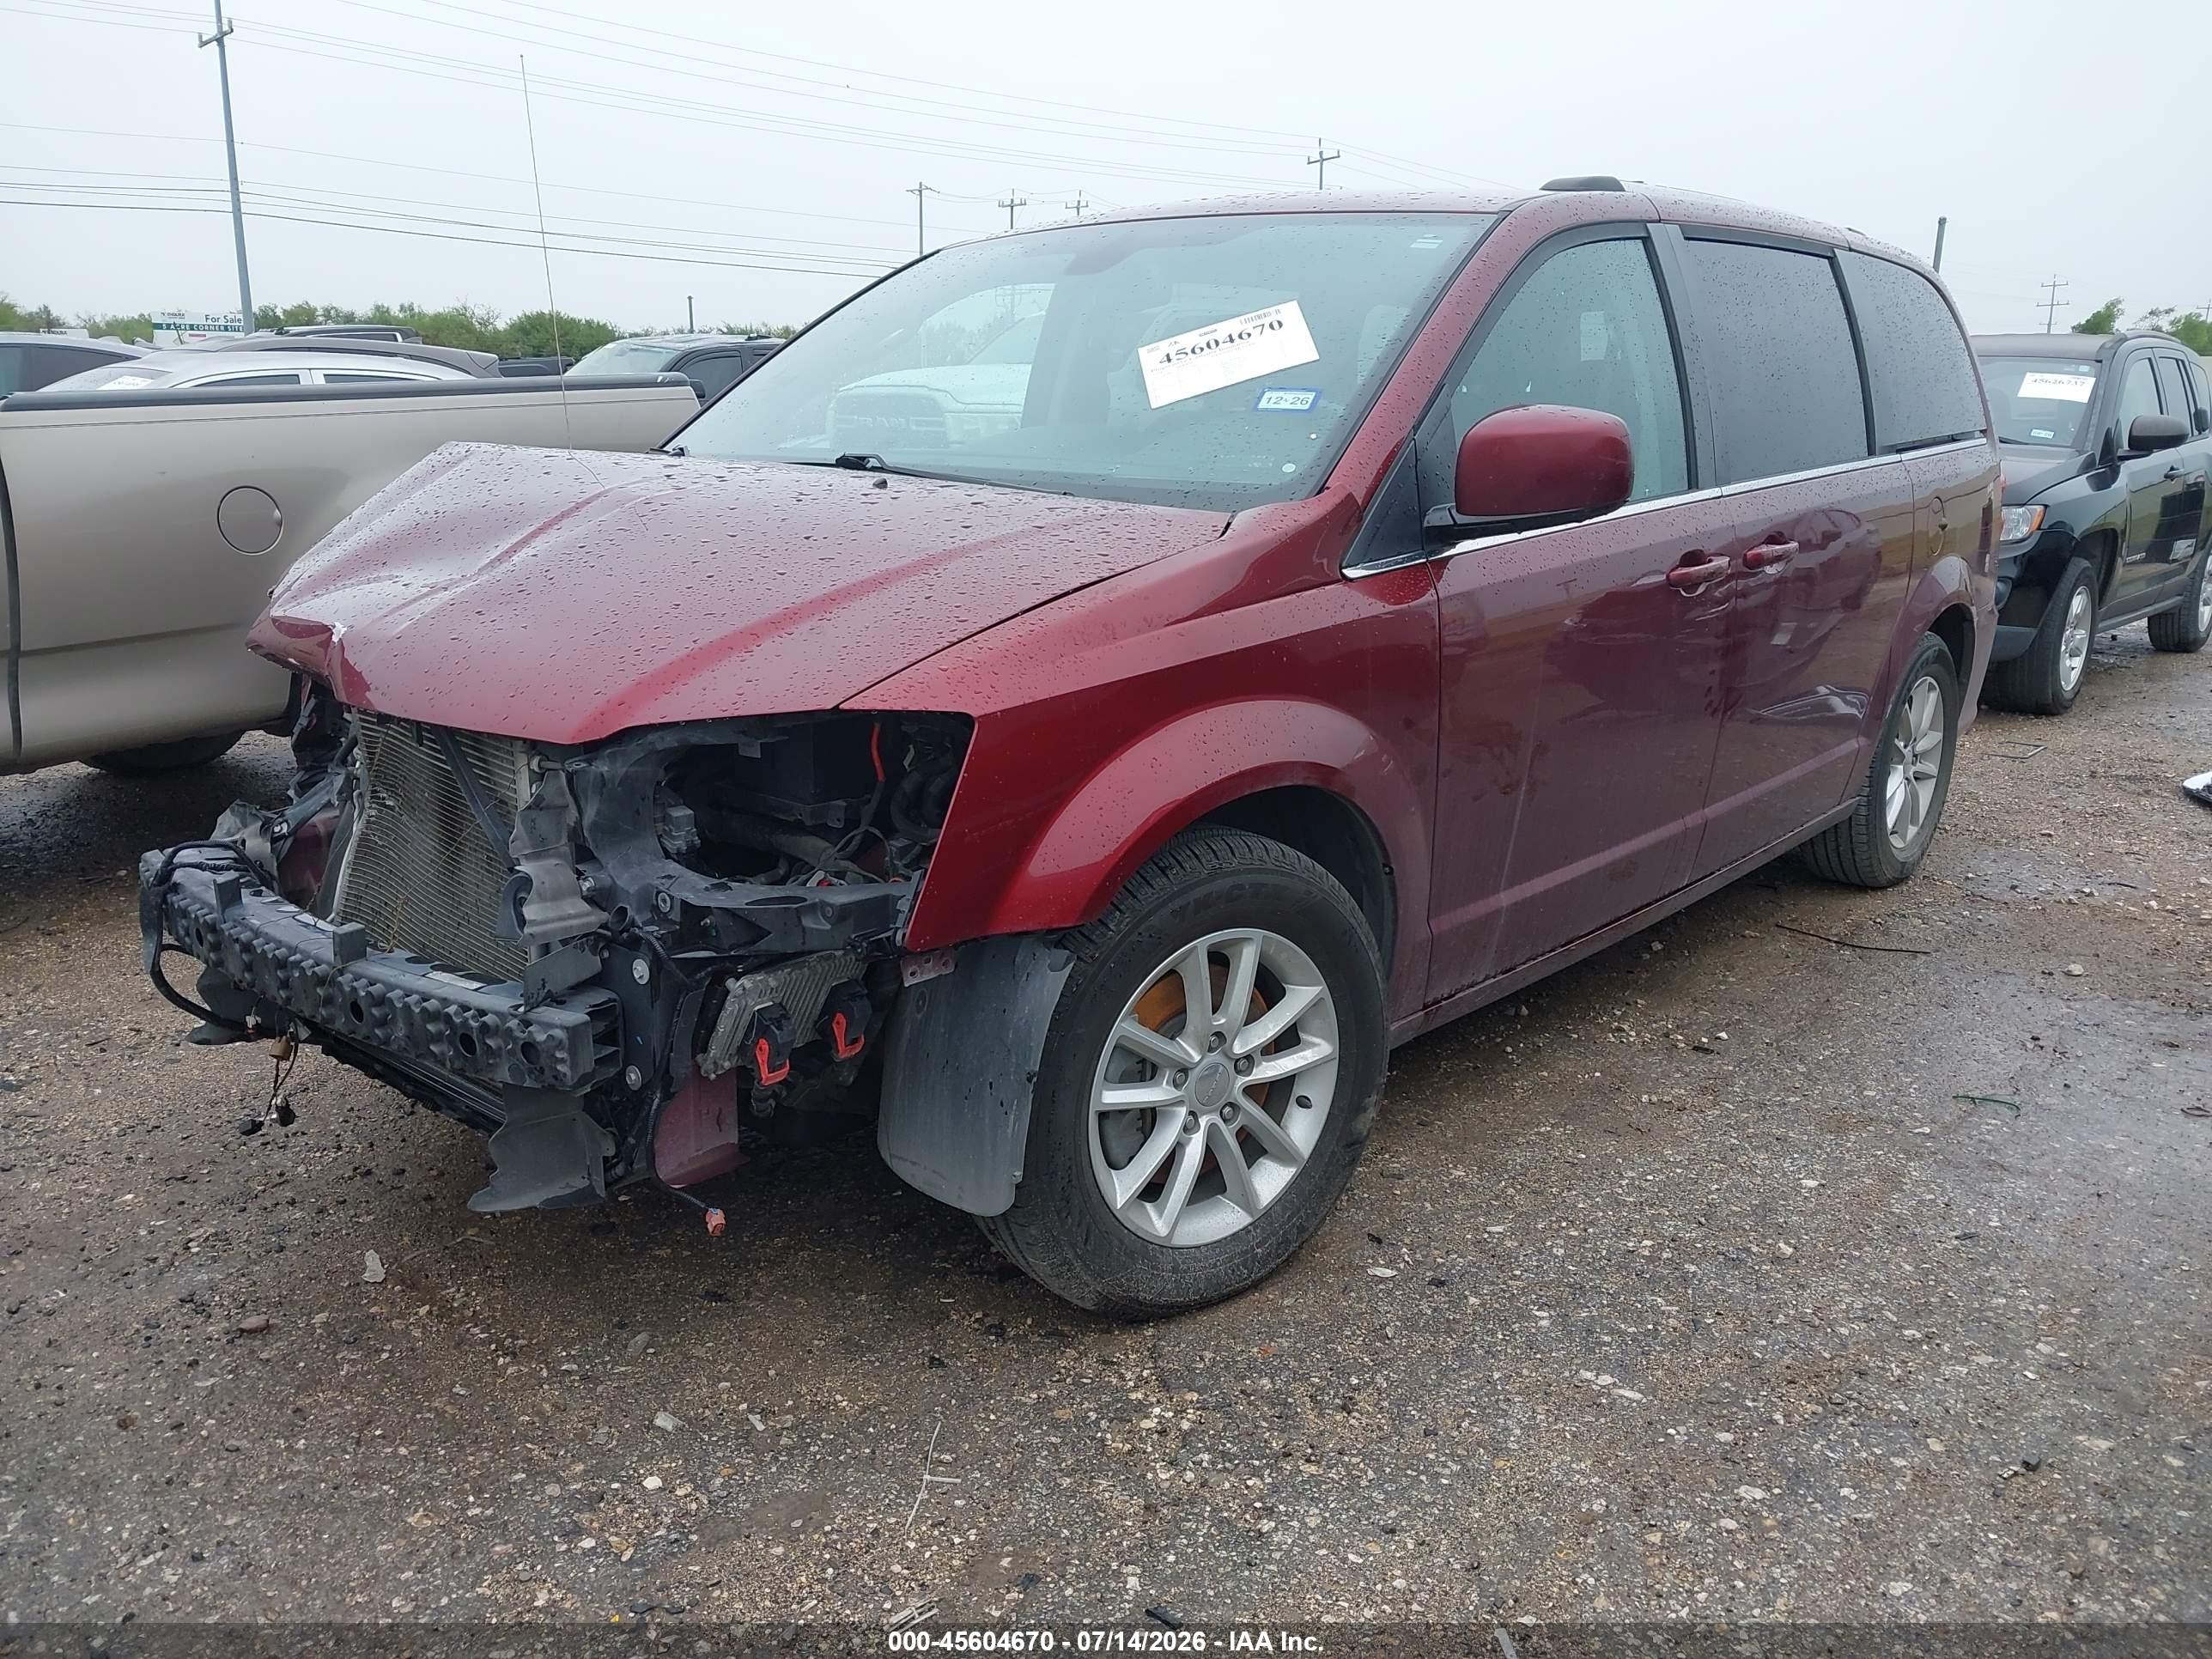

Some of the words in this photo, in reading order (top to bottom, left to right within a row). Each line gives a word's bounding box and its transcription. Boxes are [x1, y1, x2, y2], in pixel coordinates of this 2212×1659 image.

[204, 314, 221, 324] For
[224, 314, 242, 325] Sale
[1158, 319, 1284, 365] 45604670
